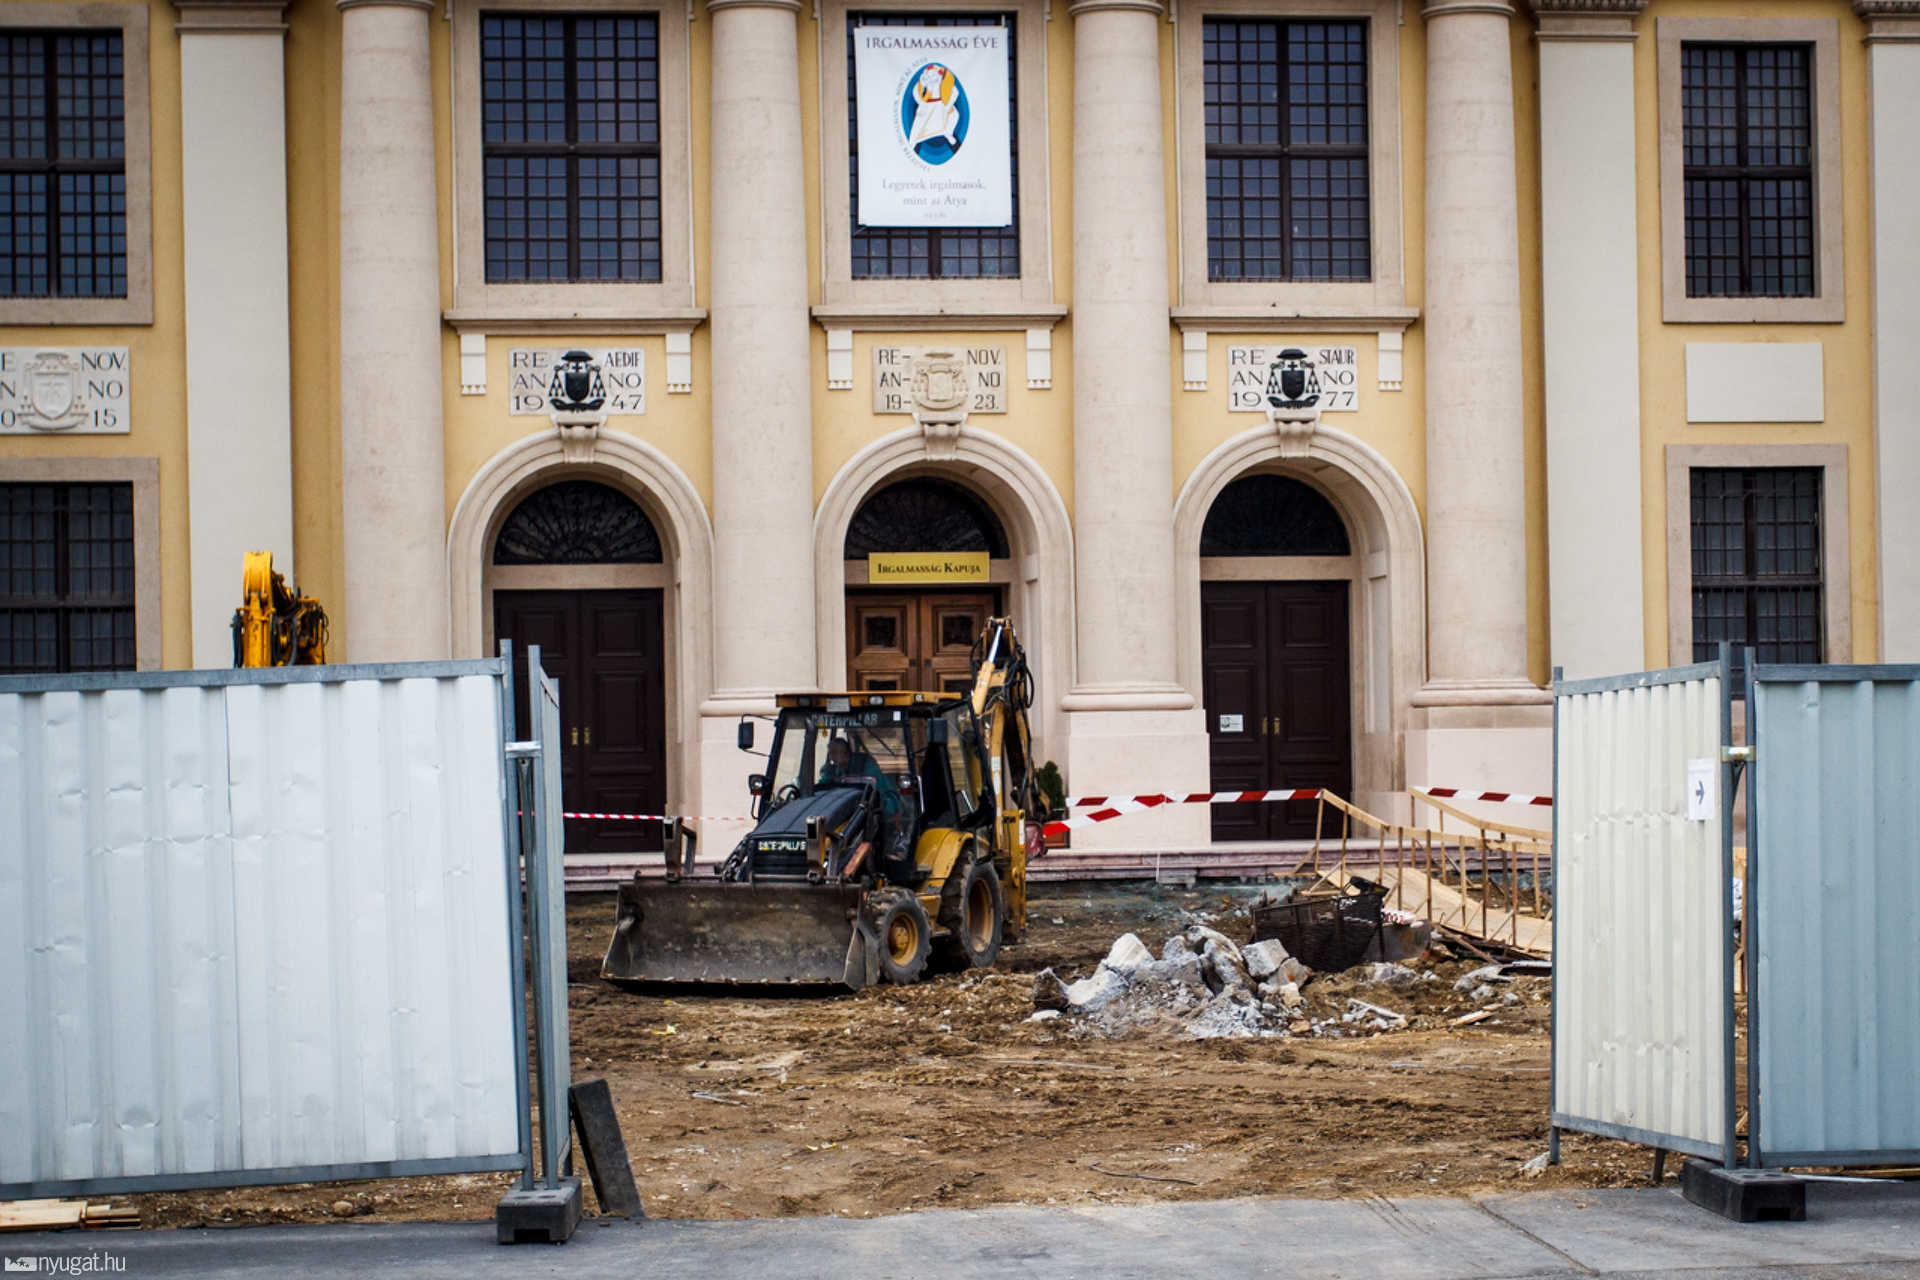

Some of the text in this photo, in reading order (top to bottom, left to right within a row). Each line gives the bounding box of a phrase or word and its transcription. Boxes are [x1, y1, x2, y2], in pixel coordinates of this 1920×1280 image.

[866, 34, 999, 49] IRGALMASSÁG ÉVE
[903, 195, 928, 206] mint
[513, 352, 549, 368] RE
[1231, 349, 1265, 365] RE
[513, 373, 642, 389] AN NO
[978, 372, 1001, 387] NO
[1232, 371, 1354, 386] AN NO
[88, 380, 123, 399] NO
[514, 395, 642, 411] 19 47
[1232, 391, 1355, 407] 19 77
[94, 408, 117, 428] 15
